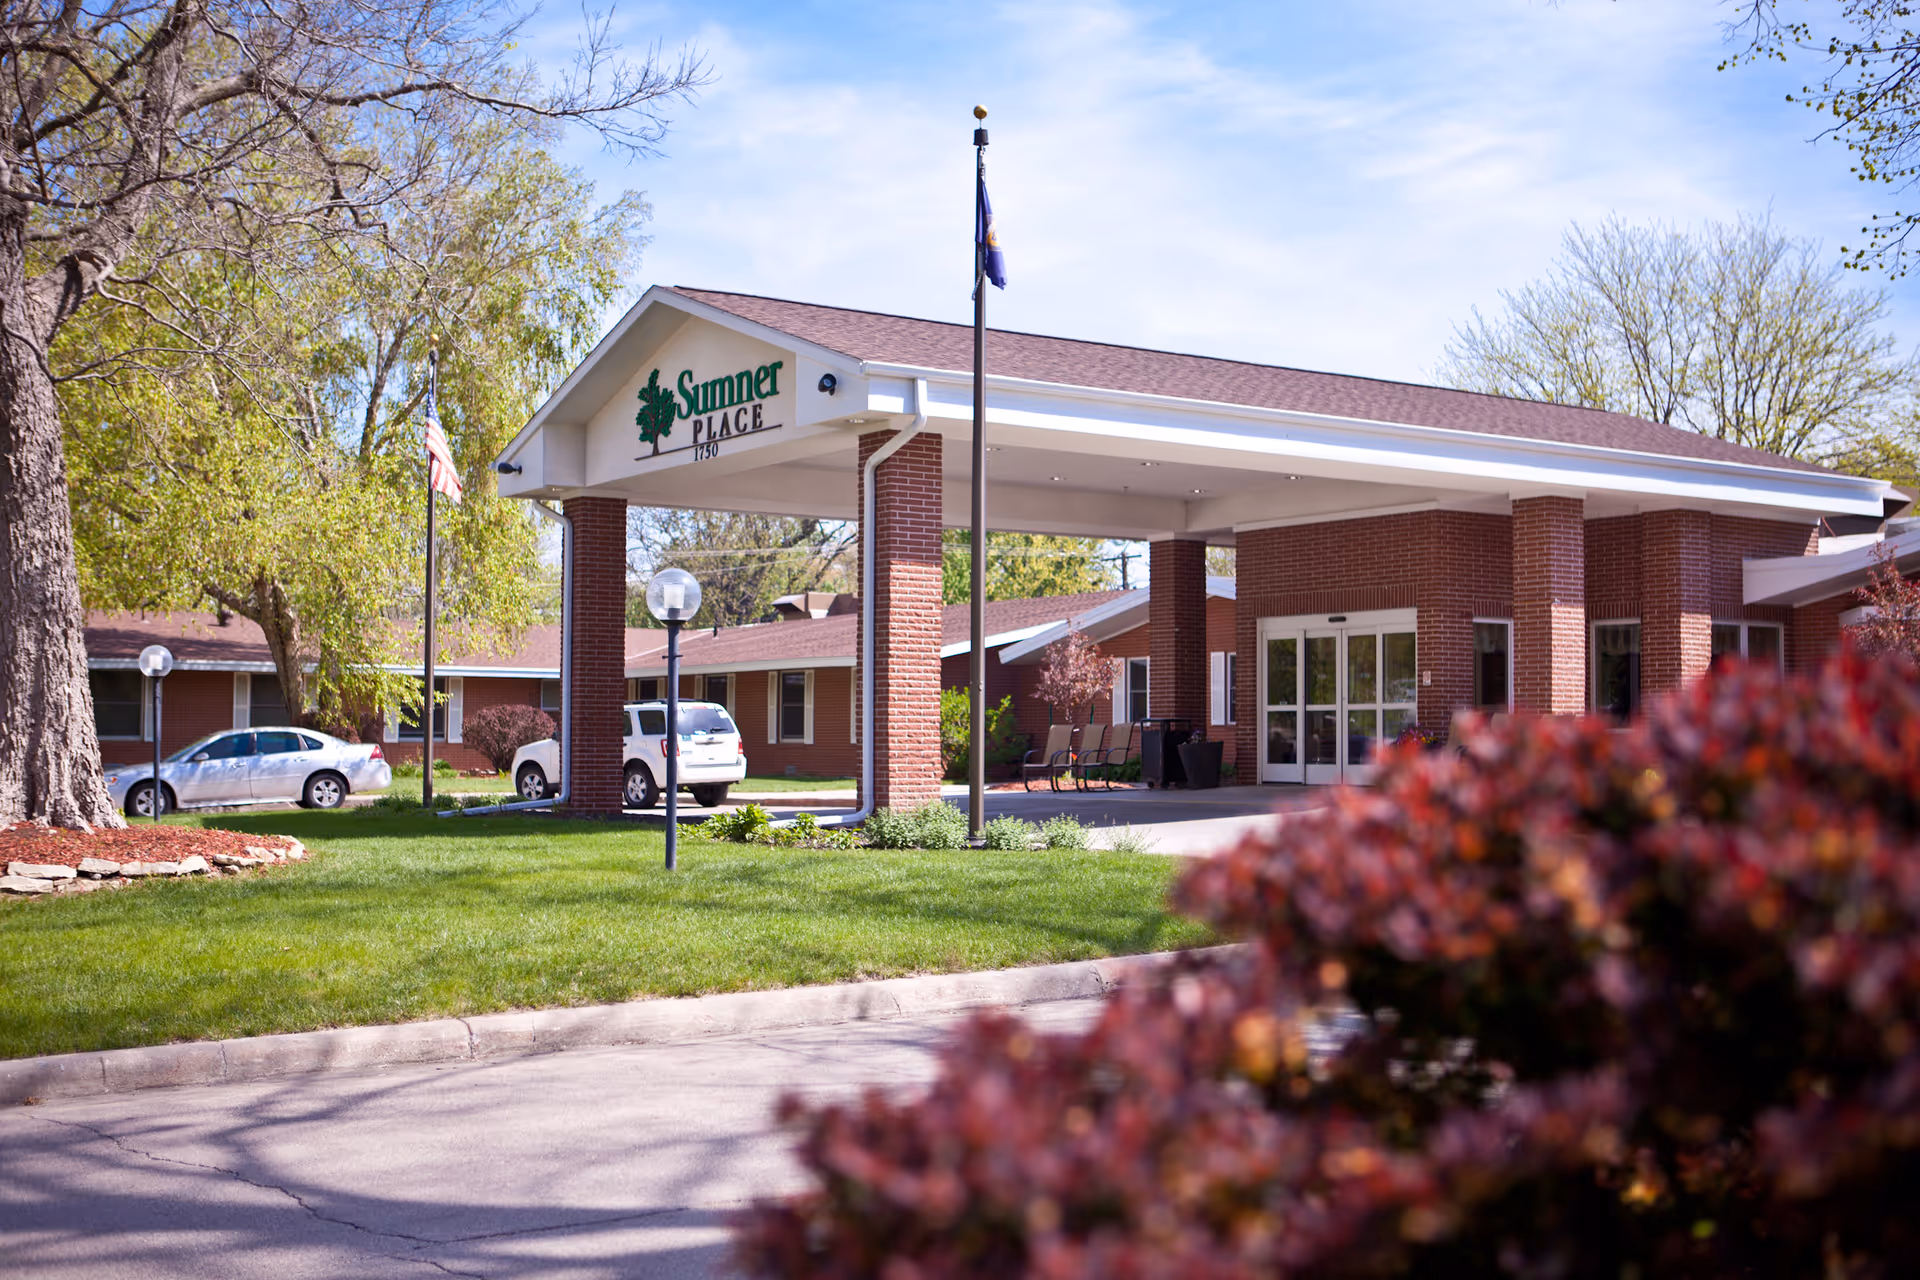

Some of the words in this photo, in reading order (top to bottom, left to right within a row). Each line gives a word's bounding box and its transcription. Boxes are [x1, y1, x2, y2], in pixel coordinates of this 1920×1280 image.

[677, 361, 783, 420] Sumner
[692, 403, 763, 444] PLACE
[694, 443, 719, 461] 1750
